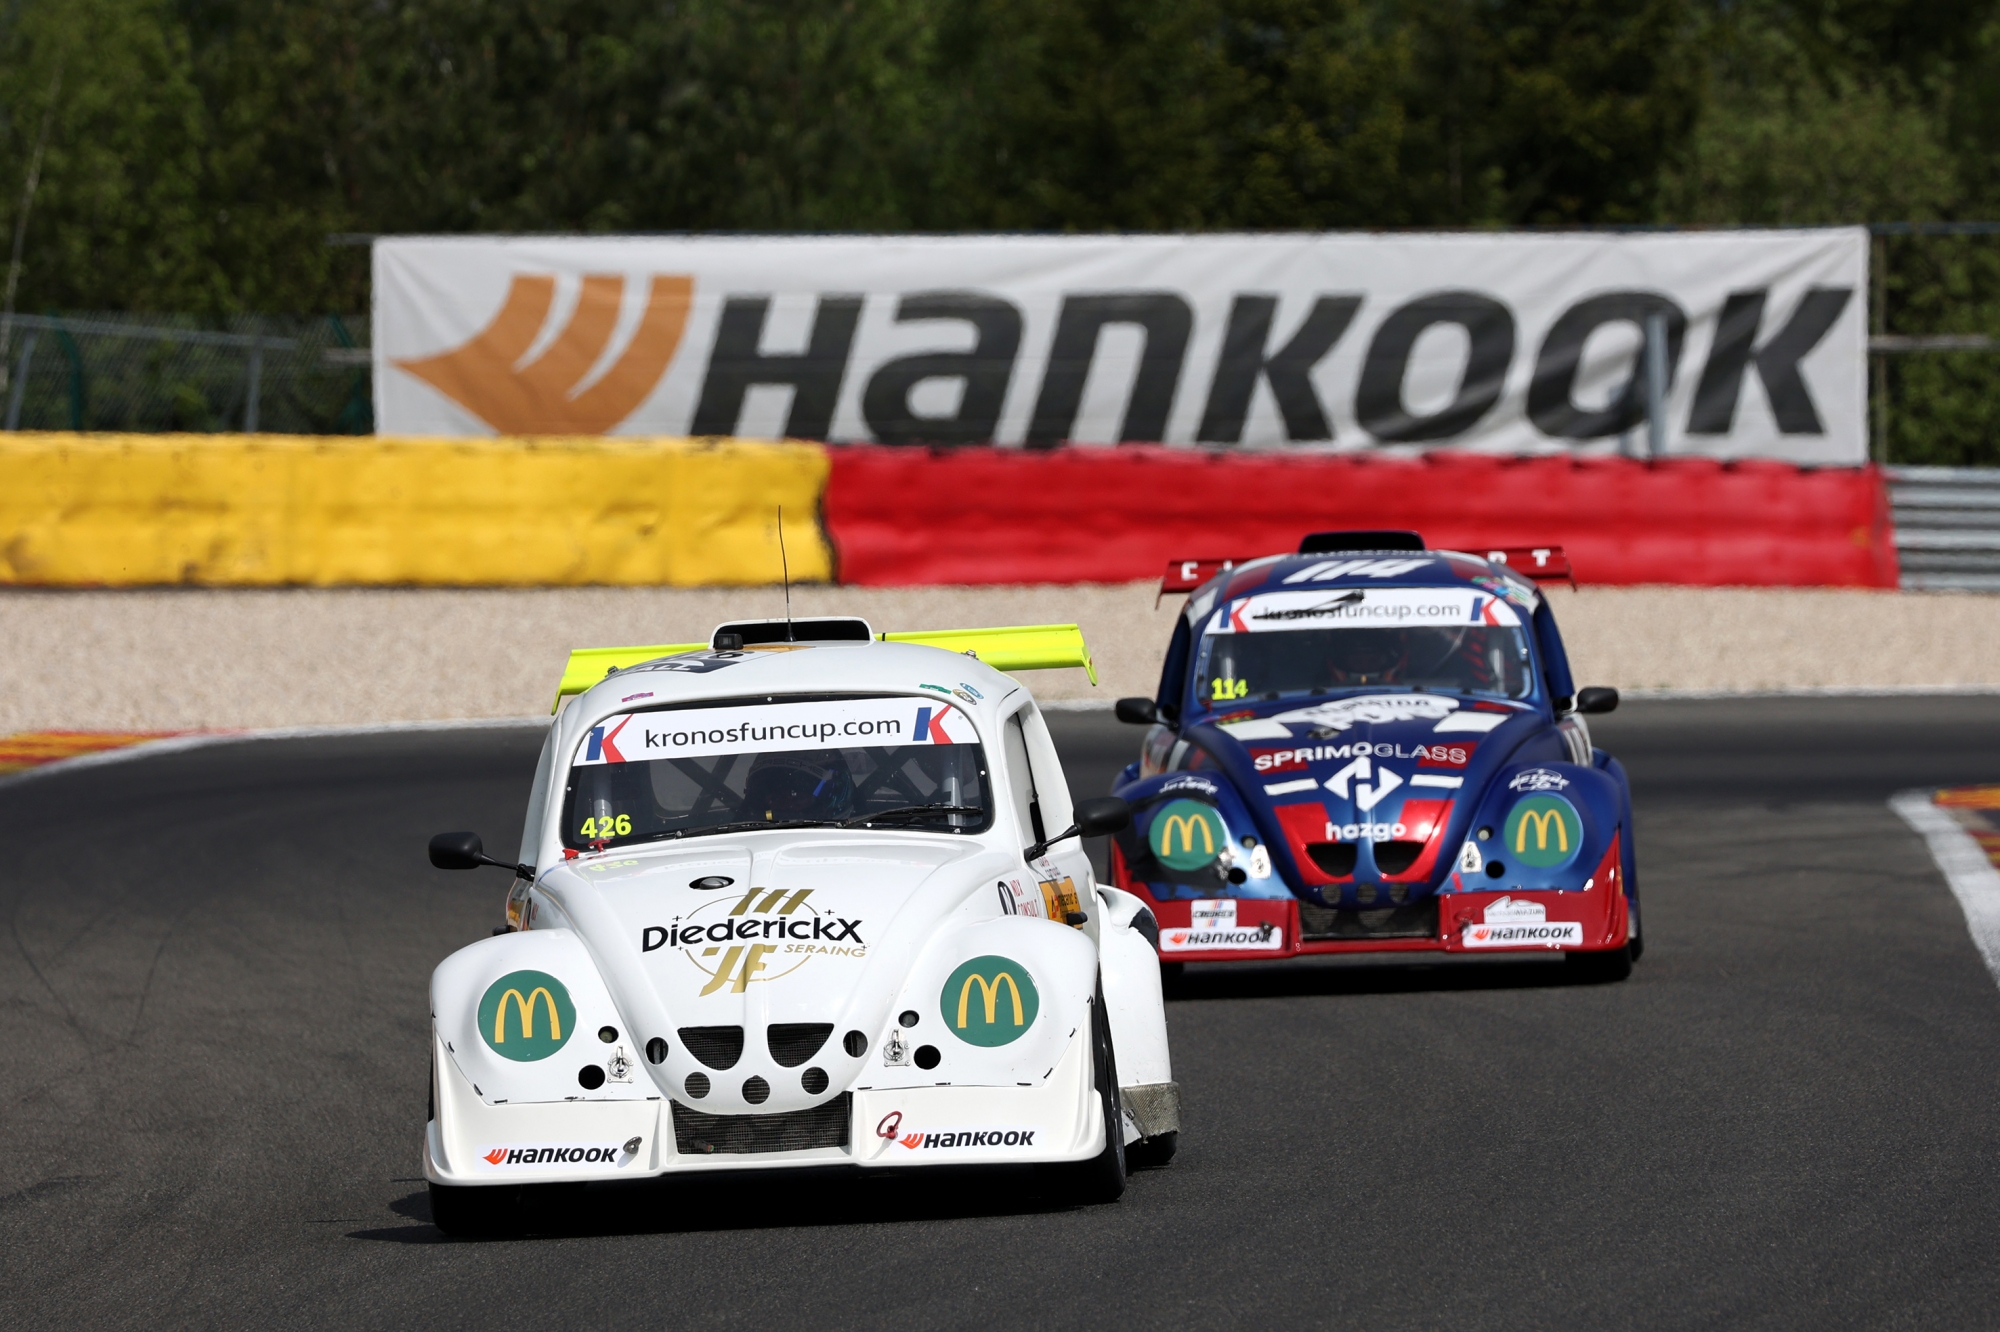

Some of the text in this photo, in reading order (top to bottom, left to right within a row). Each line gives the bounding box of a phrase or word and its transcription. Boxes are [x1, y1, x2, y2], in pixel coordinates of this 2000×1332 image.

[1281, 558, 1436, 585] 114
[1211, 677, 1249, 700] 114
[645, 717, 901, 748] kronosfuncup.com
[1254, 741, 1468, 771] SPRIMOGLASS
[580, 814, 632, 839] 426
[1325, 821, 1407, 843] hazgo
[784, 943, 867, 958] SERAING
